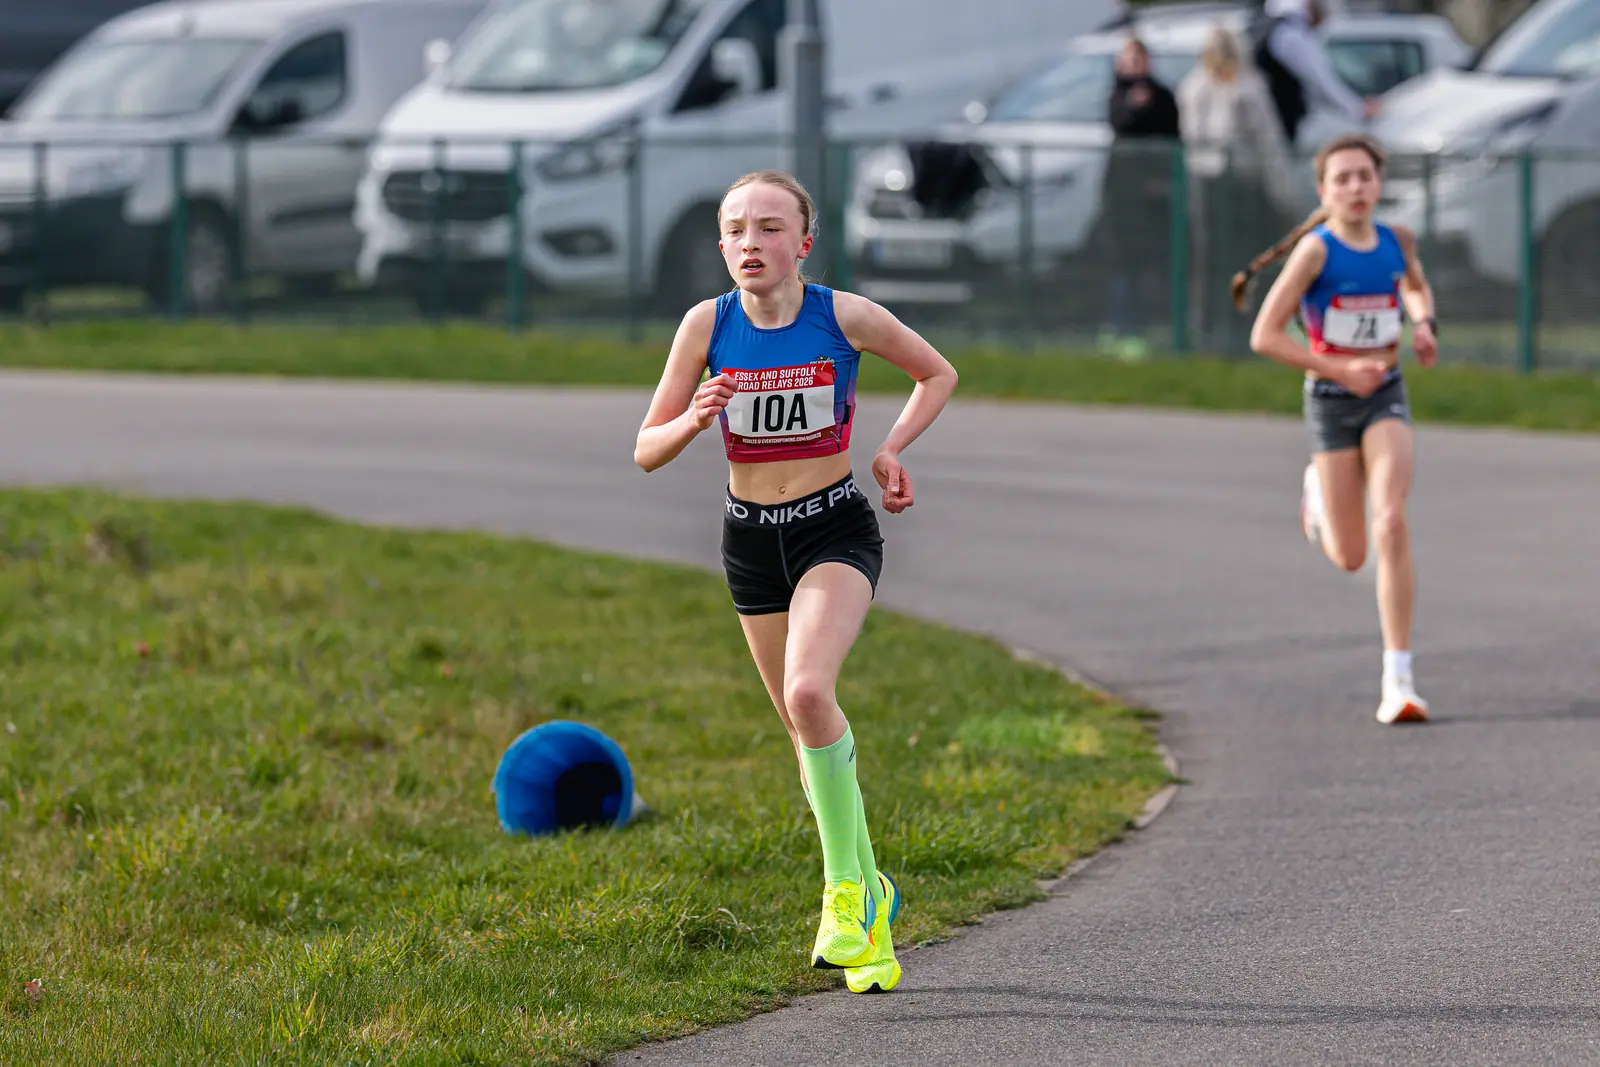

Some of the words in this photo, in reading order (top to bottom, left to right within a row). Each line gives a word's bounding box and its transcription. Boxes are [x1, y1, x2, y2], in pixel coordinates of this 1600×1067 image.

[734, 371, 759, 382] ESSEX
[760, 370, 778, 381] AND
[779, 366, 817, 379] SUFFOLK
[738, 381, 760, 391] ROAD
[761, 379, 793, 390] RELAYS
[794, 376, 814, 387] 2026
[752, 393, 808, 433] 10A
[759, 496, 823, 525] NIKE
[828, 478, 858, 508] PR
